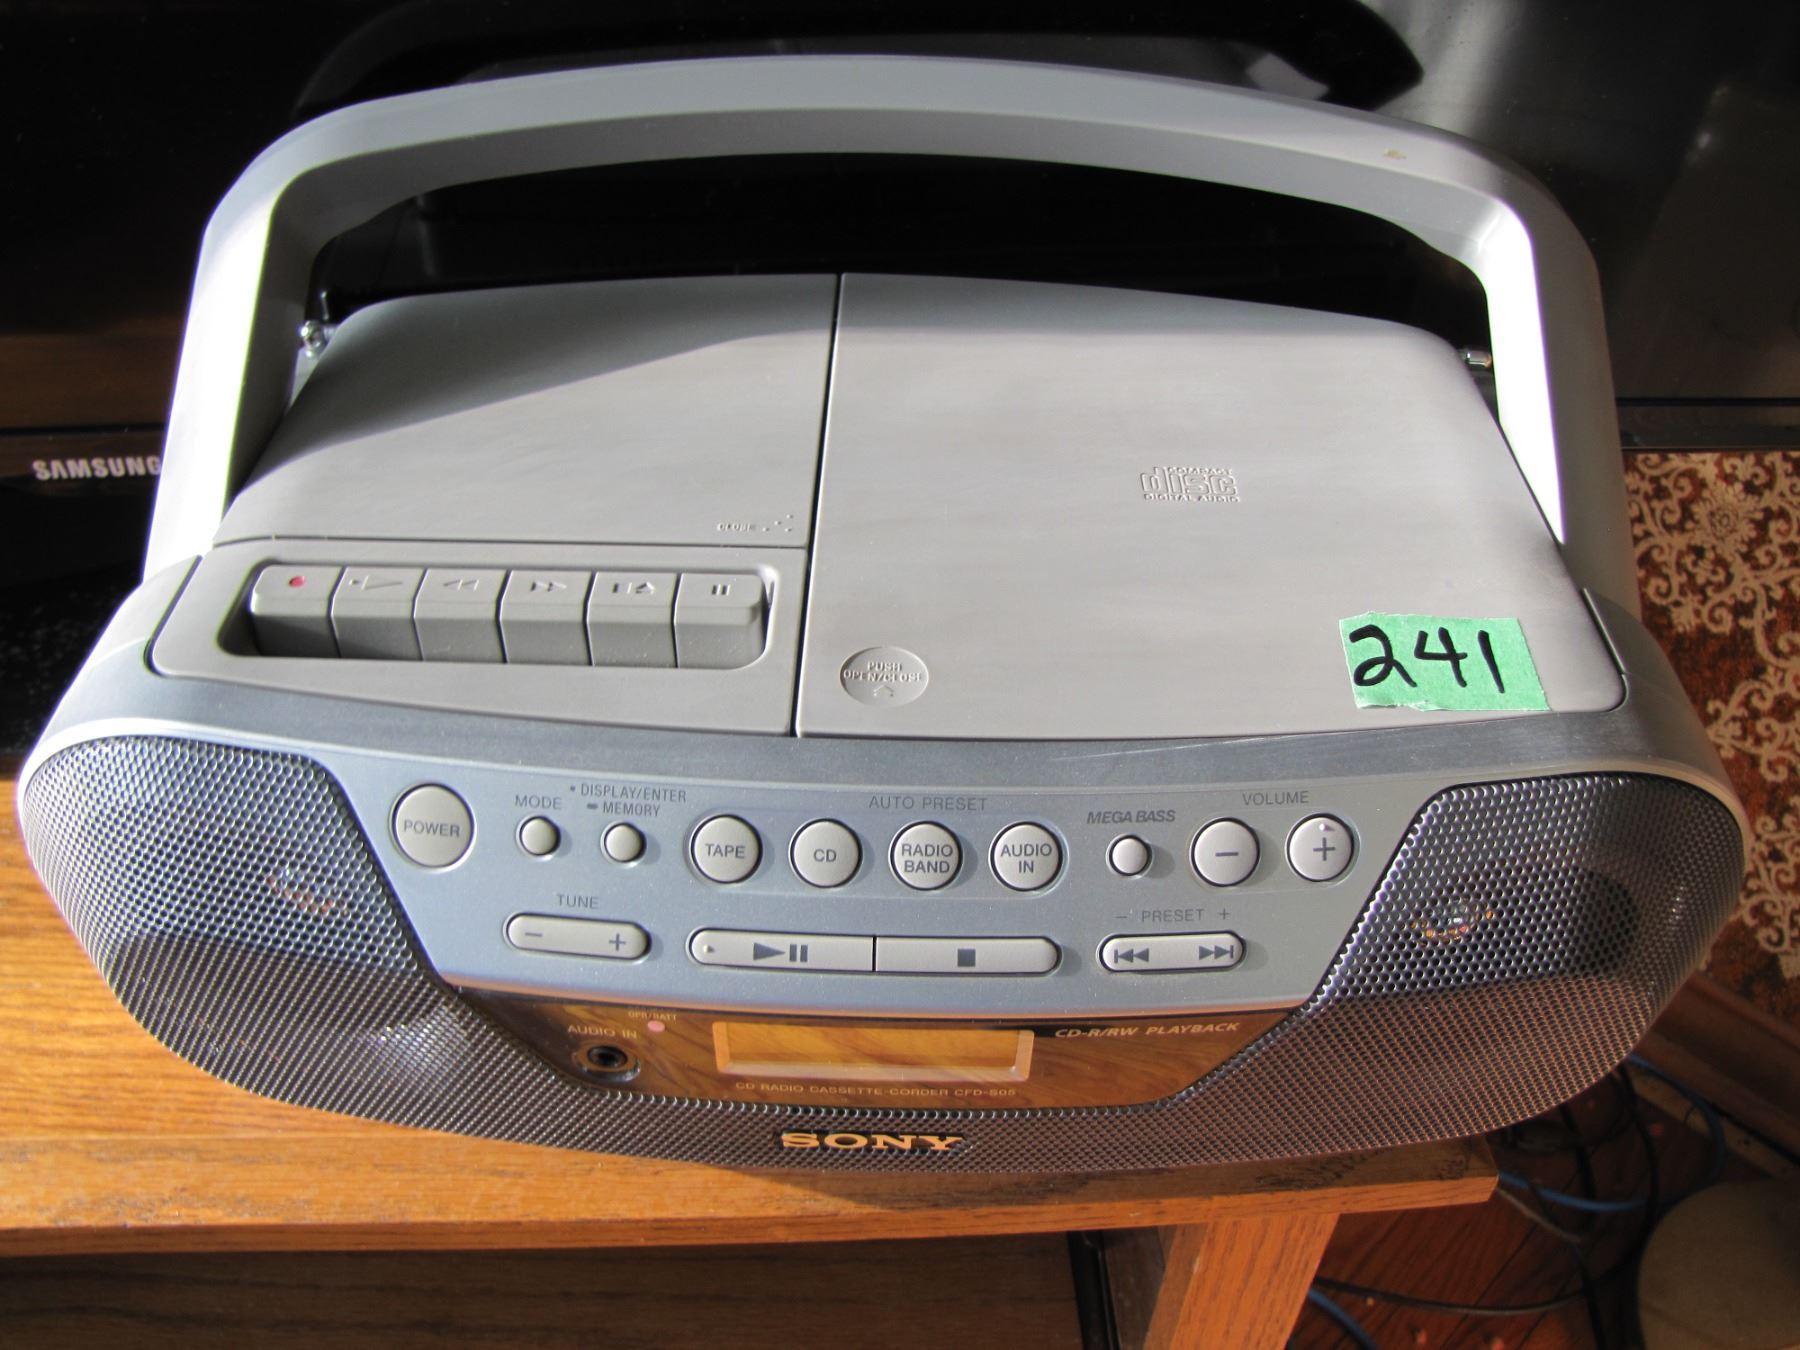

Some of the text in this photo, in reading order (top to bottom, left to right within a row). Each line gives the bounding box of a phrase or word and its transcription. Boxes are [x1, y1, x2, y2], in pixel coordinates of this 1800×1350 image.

[32, 456, 163, 481] SAMSUNG
[867, 661, 903, 671] PUSH
[1349, 624, 1505, 693] 241
[581, 784, 687, 803] DISPLAY/ENTER
[1242, 791, 1310, 806] VOLUME
[515, 794, 562, 810] MODE
[603, 802, 661, 817] MEMORY
[869, 796, 988, 811] AUTO PRESET
[1087, 809, 1176, 825] MEGA BASS
[404, 820, 460, 838] POWER
[705, 843, 746, 859] TAPE
[813, 849, 837, 863] CD
[901, 843, 953, 857] RADIO
[1000, 843, 1052, 857] AUDIO
[904, 860, 950, 874] BAND
[1018, 860, 1035, 874] IN
[557, 894, 599, 909] TUNE
[1142, 909, 1205, 923] PRESET
[568, 1024, 638, 1039] AUDIO IN
[1055, 1022, 1241, 1038] CD-R/RW PLAYBACK
[735, 1082, 755, 1090] CD
[760, 1083, 805, 1093] RADIO
[781, 1132, 963, 1151] SONY
